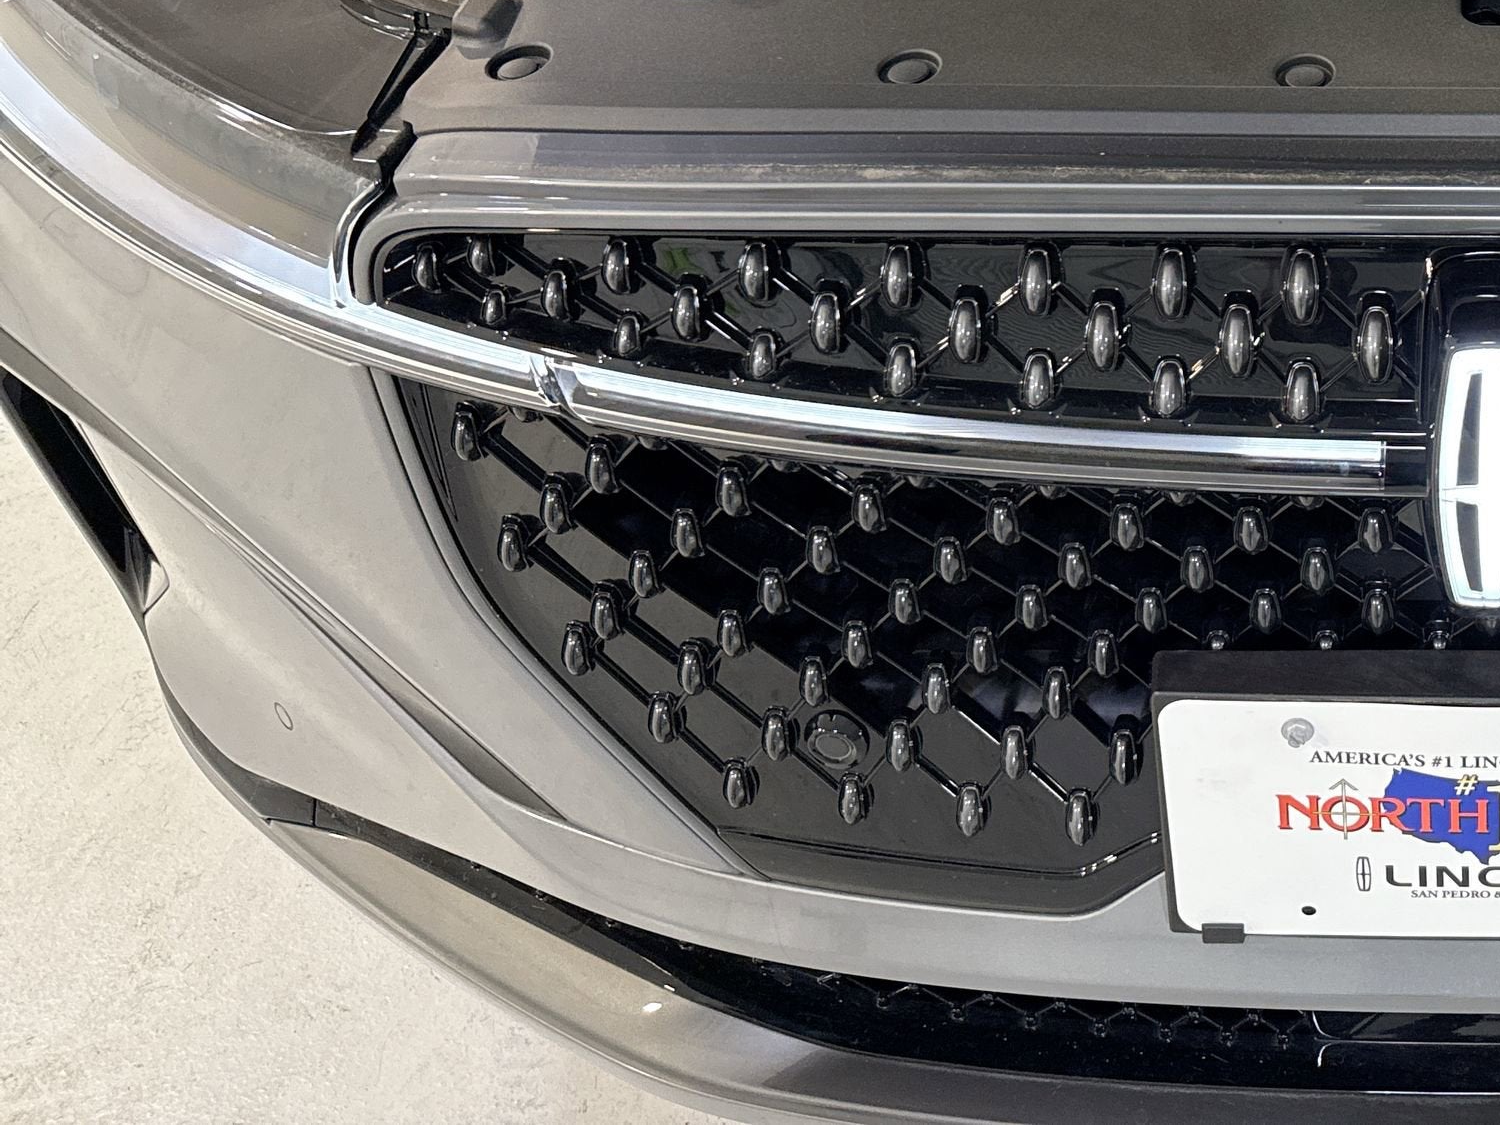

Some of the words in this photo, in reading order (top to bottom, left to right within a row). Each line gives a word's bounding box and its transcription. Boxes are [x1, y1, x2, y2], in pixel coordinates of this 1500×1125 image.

[1431, 755, 1453, 769] #1
[1275, 793, 1489, 834] NORTH
[1411, 890, 1438, 898] SAN
[1442, 890, 1491, 898] PEDRO
